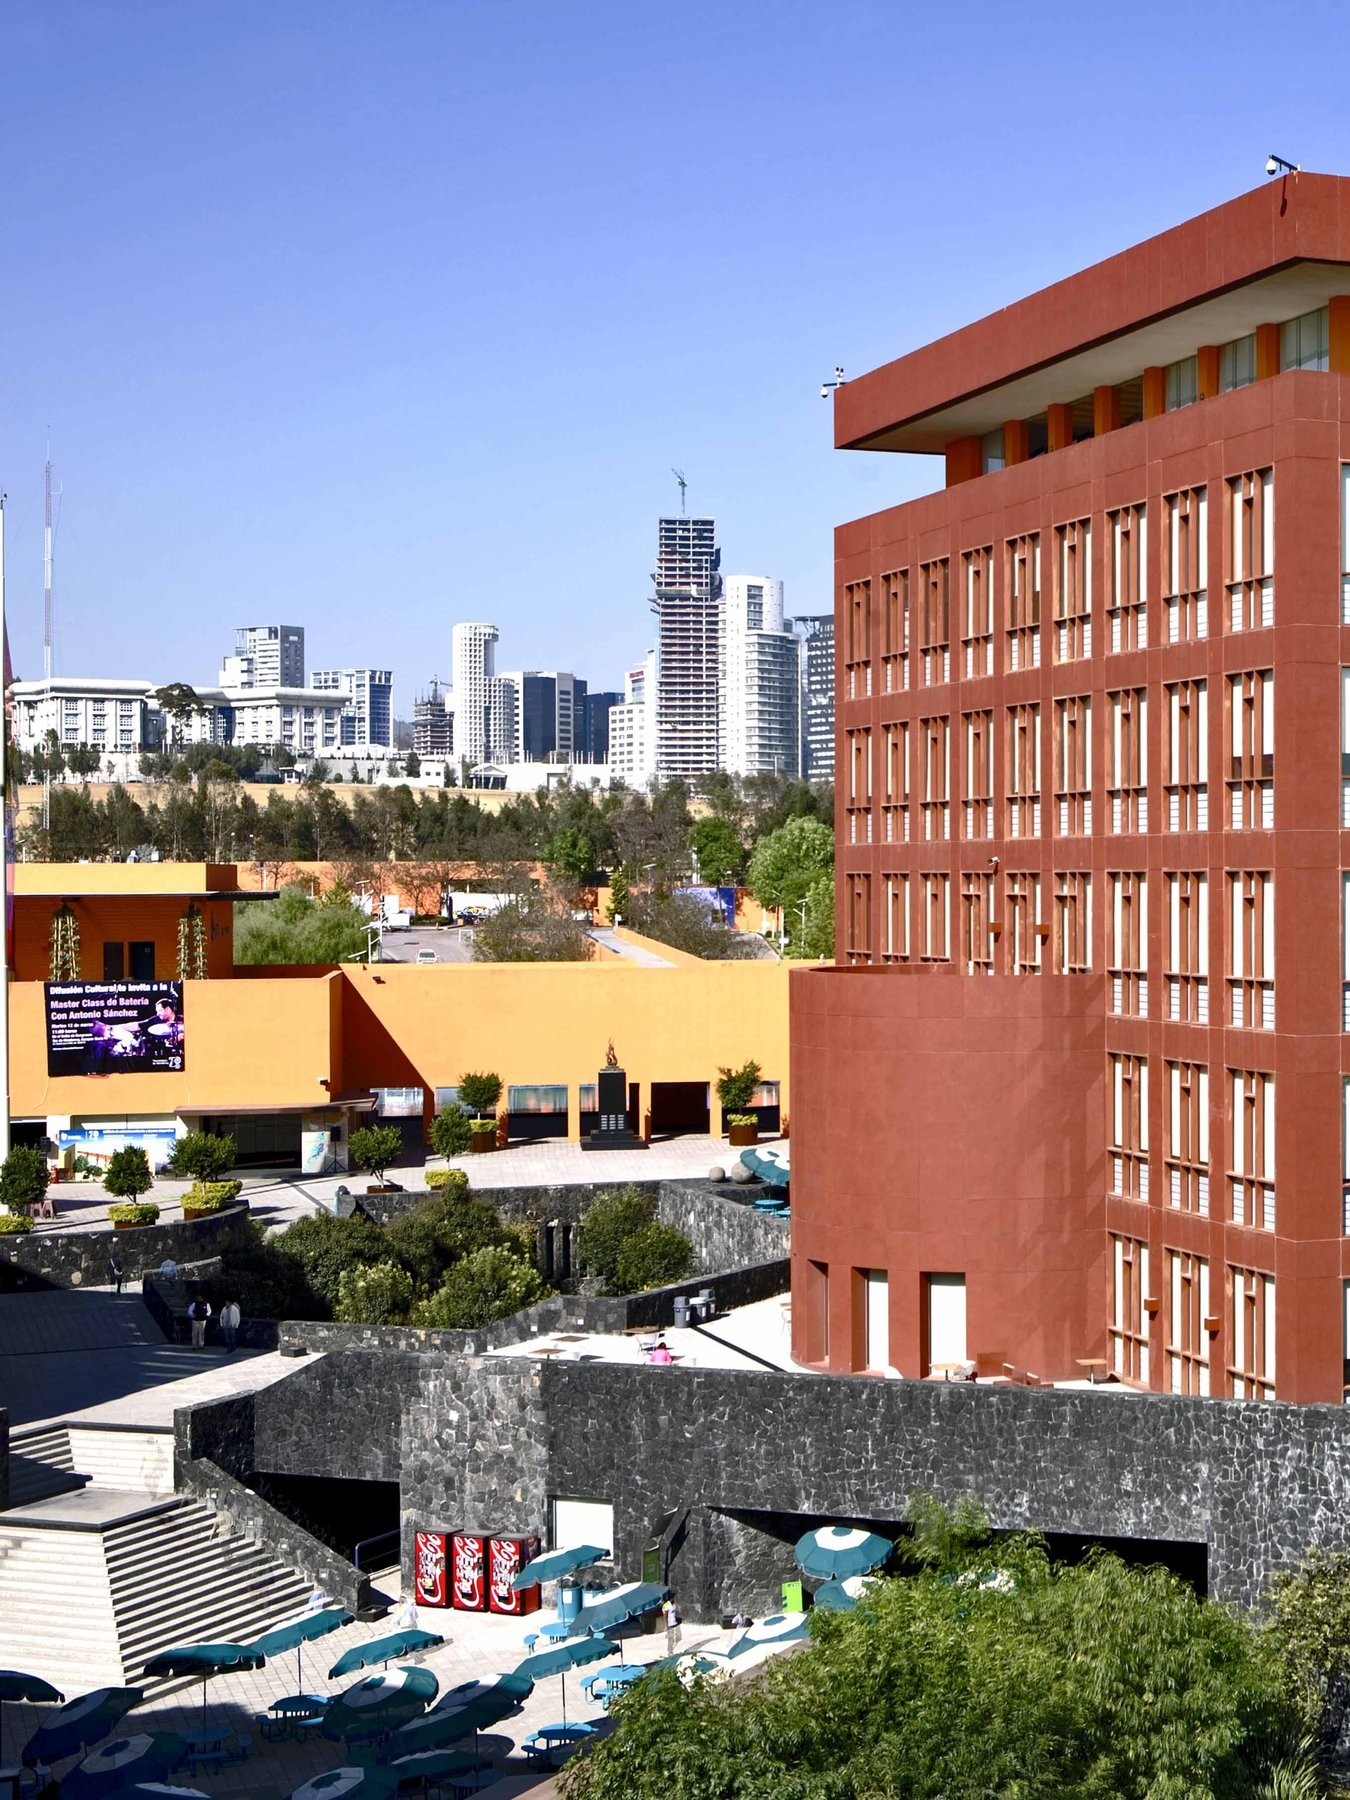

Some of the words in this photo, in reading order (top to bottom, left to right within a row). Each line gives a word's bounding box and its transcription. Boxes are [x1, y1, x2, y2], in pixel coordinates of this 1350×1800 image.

[84, 983, 117, 993] Cultural
[159, 982, 168, 991] la
[50, 1000, 80, 1009] Master
[81, 999, 105, 1007] Class
[118, 997, 150, 1006] Batería
[50, 1011, 68, 1020] Con
[68, 1010, 102, 1020] Antonio
[102, 1008, 139, 1018] Sánchez
